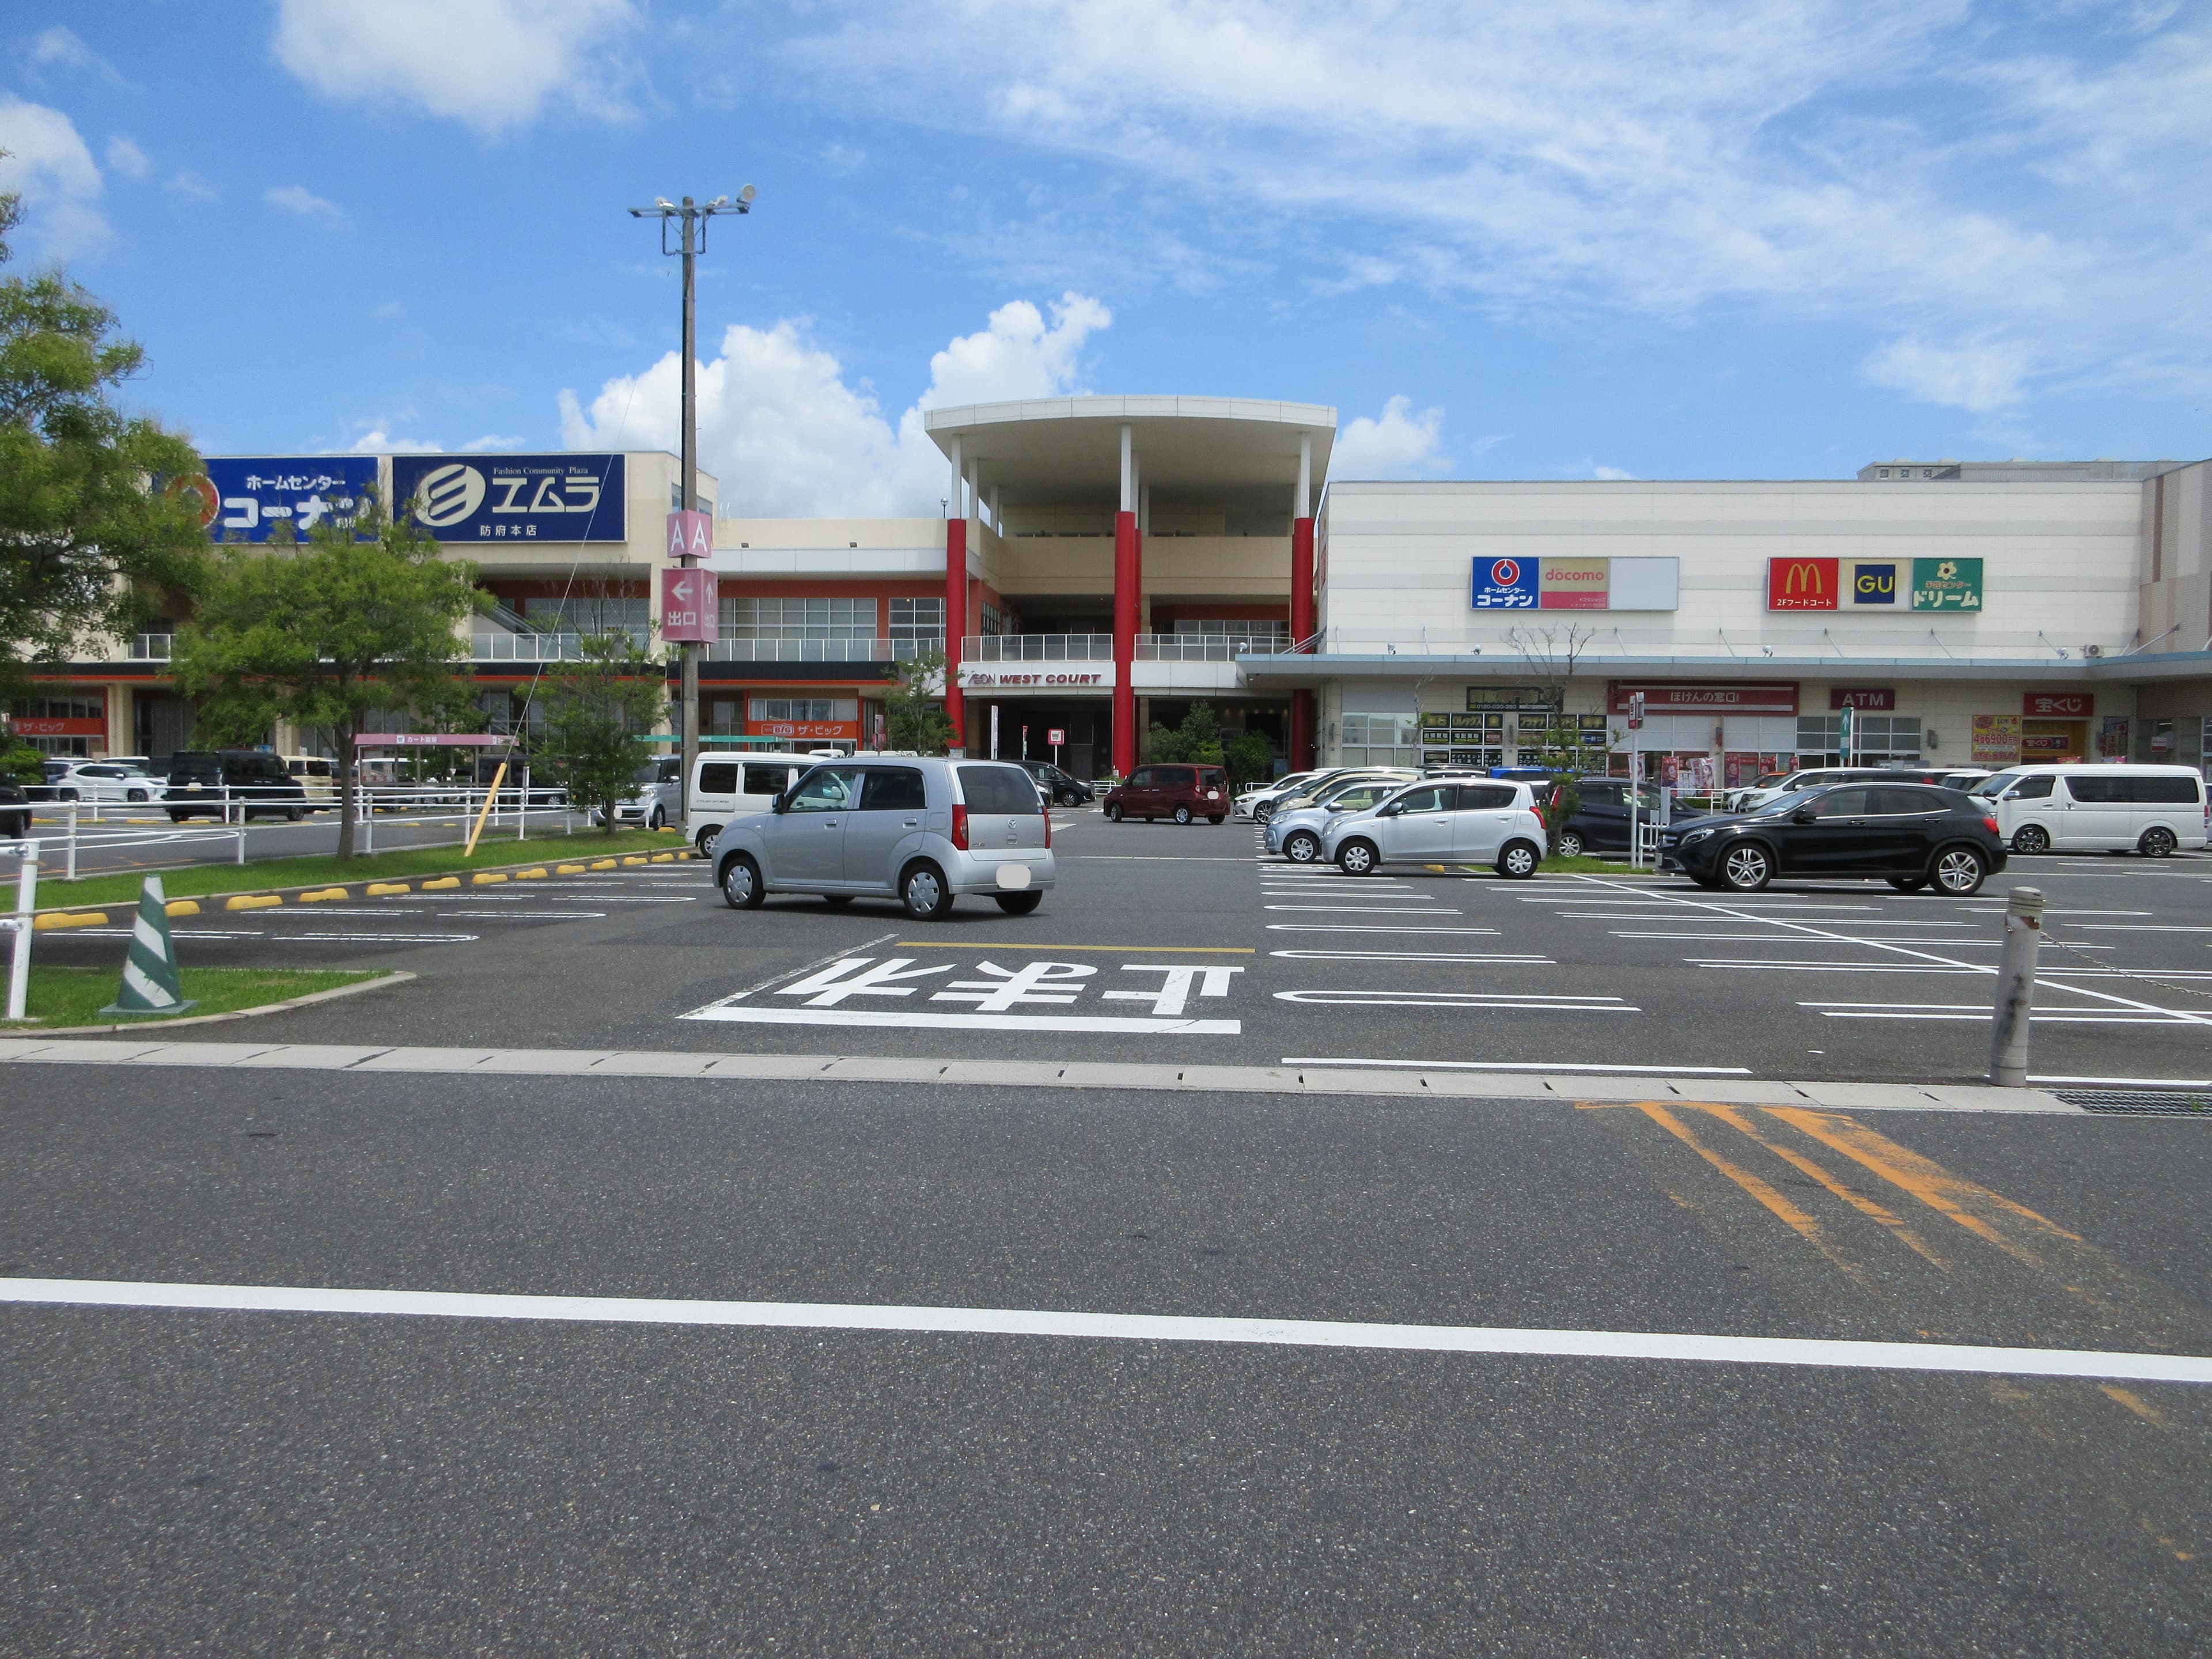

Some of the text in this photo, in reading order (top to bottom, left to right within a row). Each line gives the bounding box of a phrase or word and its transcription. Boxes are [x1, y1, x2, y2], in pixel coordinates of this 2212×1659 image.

[524, 467, 565, 476] Community
[247, 475, 346, 490] ホームセンター
[493, 476, 600, 513] エムラ
[480, 525, 537, 536] 防府本店
[671, 518, 685, 551] A
[692, 519, 708, 552] A
[1545, 569, 1604, 581] docomo
[1857, 575, 1893, 593] GU
[1477, 594, 1533, 607] コーナン
[1777, 599, 1832, 607] 2Fフードコート
[1913, 590, 1979, 607] ドリーム
[668, 611, 696, 626] 出口
[704, 613, 715, 628] 出口
[999, 675, 1042, 684] WEST
[1046, 674, 1101, 684] COURT
[1842, 694, 1884, 706] ATM
[2035, 698, 2082, 712] 宝くじ
[797, 725, 844, 736] ザ・ビッグ
[774, 957, 1245, 1016] 止まれ
